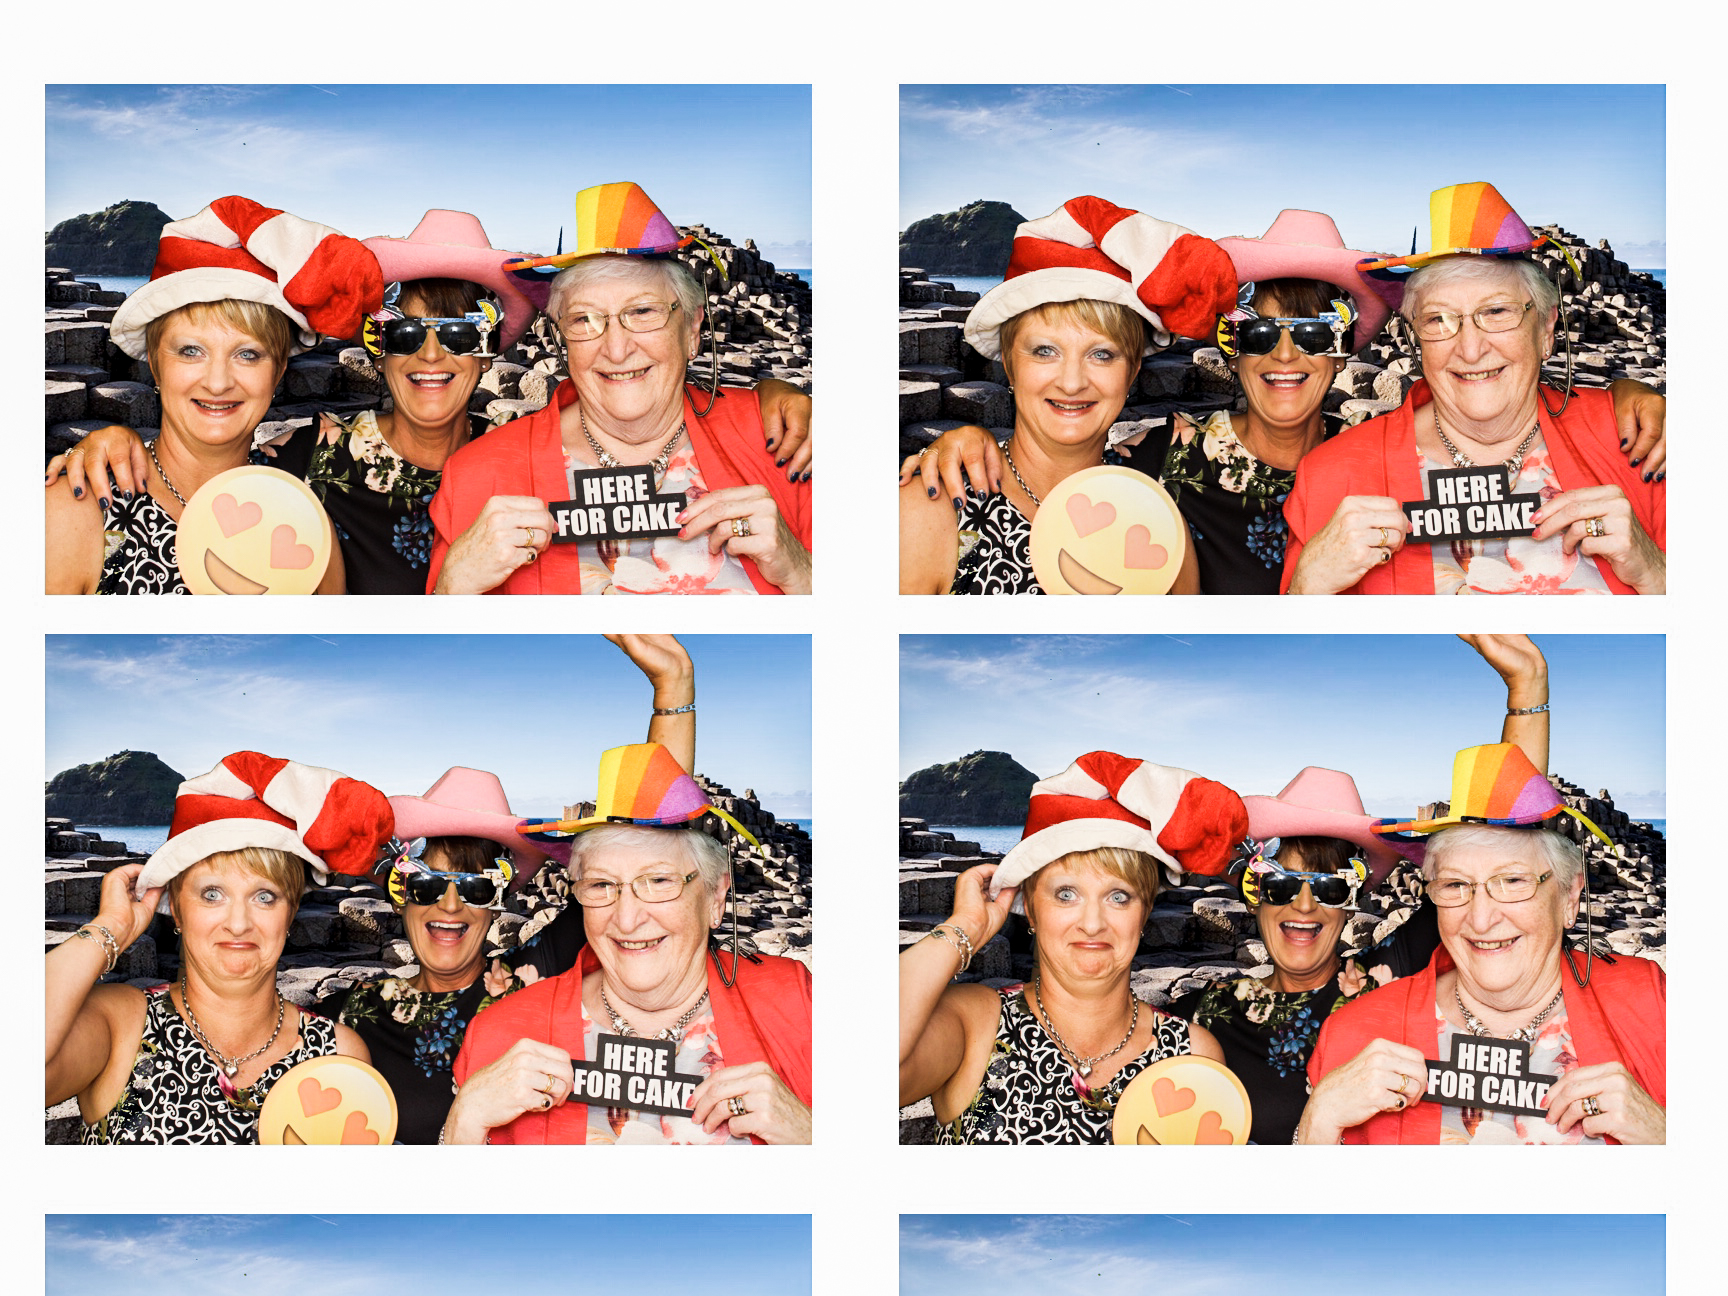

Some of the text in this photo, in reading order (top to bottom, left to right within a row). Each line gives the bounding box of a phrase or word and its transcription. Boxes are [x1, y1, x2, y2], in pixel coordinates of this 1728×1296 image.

[582, 473, 650, 505] HERE
[1436, 473, 1504, 505] HERE
[556, 501, 683, 537] FOR CAKE
[1410, 501, 1537, 537] FOR CAKE
[603, 1042, 668, 1077] HERE
[1457, 1042, 1522, 1077] HERE
[573, 1068, 621, 1101] FOR
[1427, 1068, 1475, 1101] FOR
